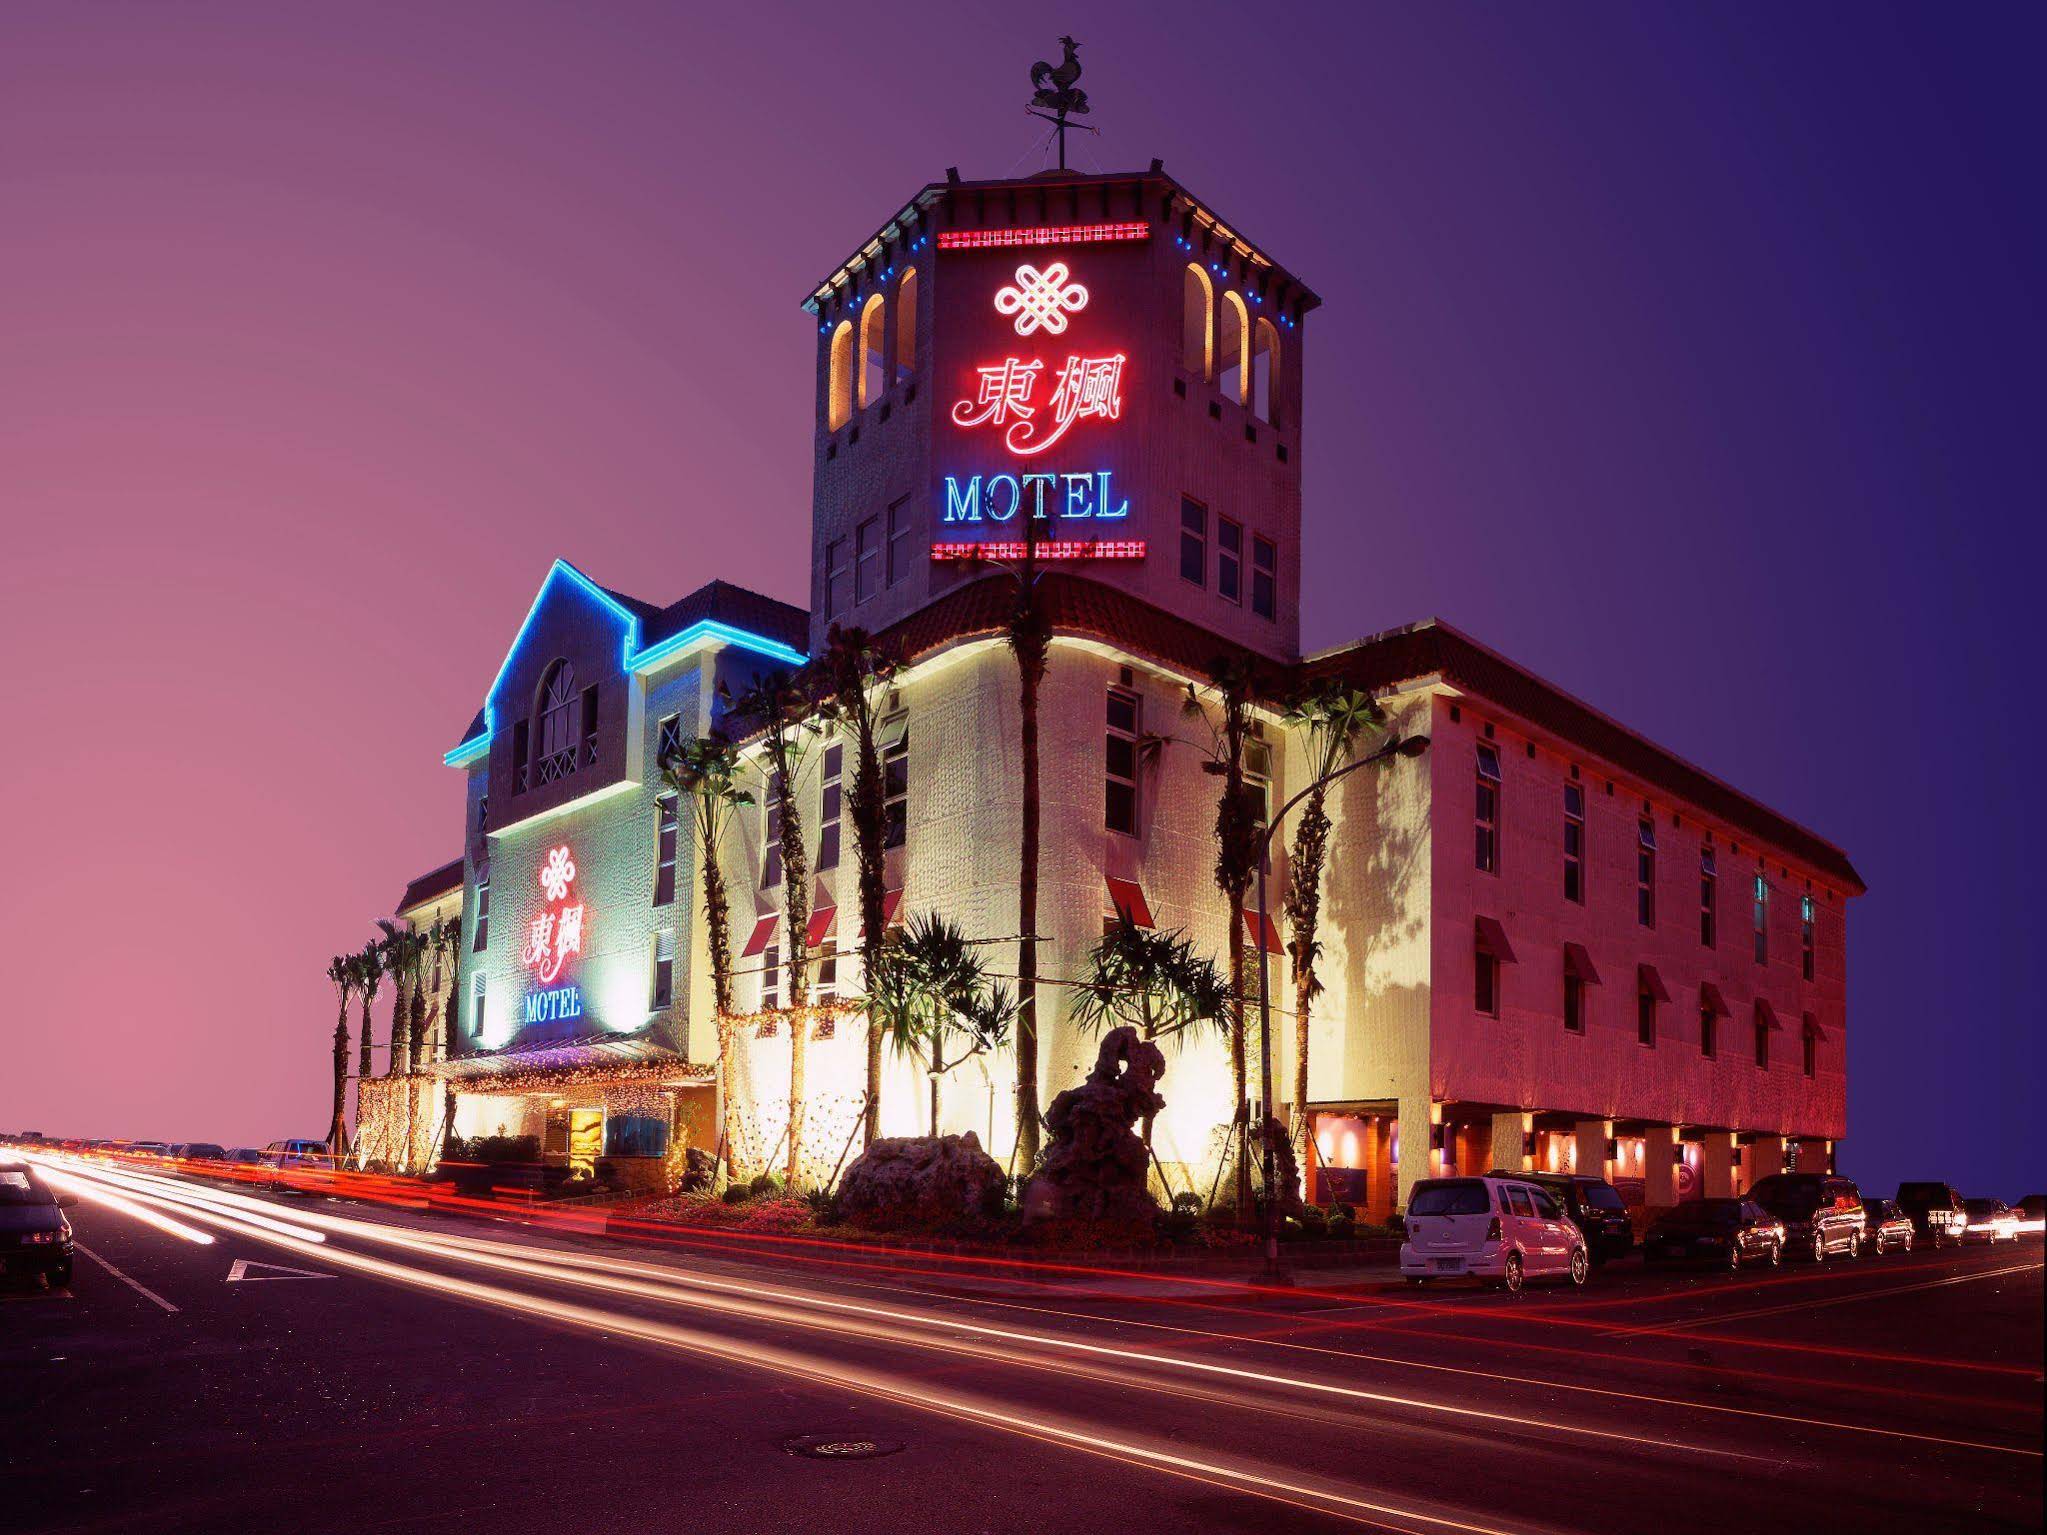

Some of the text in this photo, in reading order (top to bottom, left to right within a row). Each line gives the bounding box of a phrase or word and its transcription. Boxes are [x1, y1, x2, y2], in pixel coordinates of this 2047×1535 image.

[952, 354, 1126, 454] 東楓
[944, 472, 1129, 521] MOTEL
[523, 904, 584, 983] 東楓
[525, 987, 581, 1022] MOTEL
